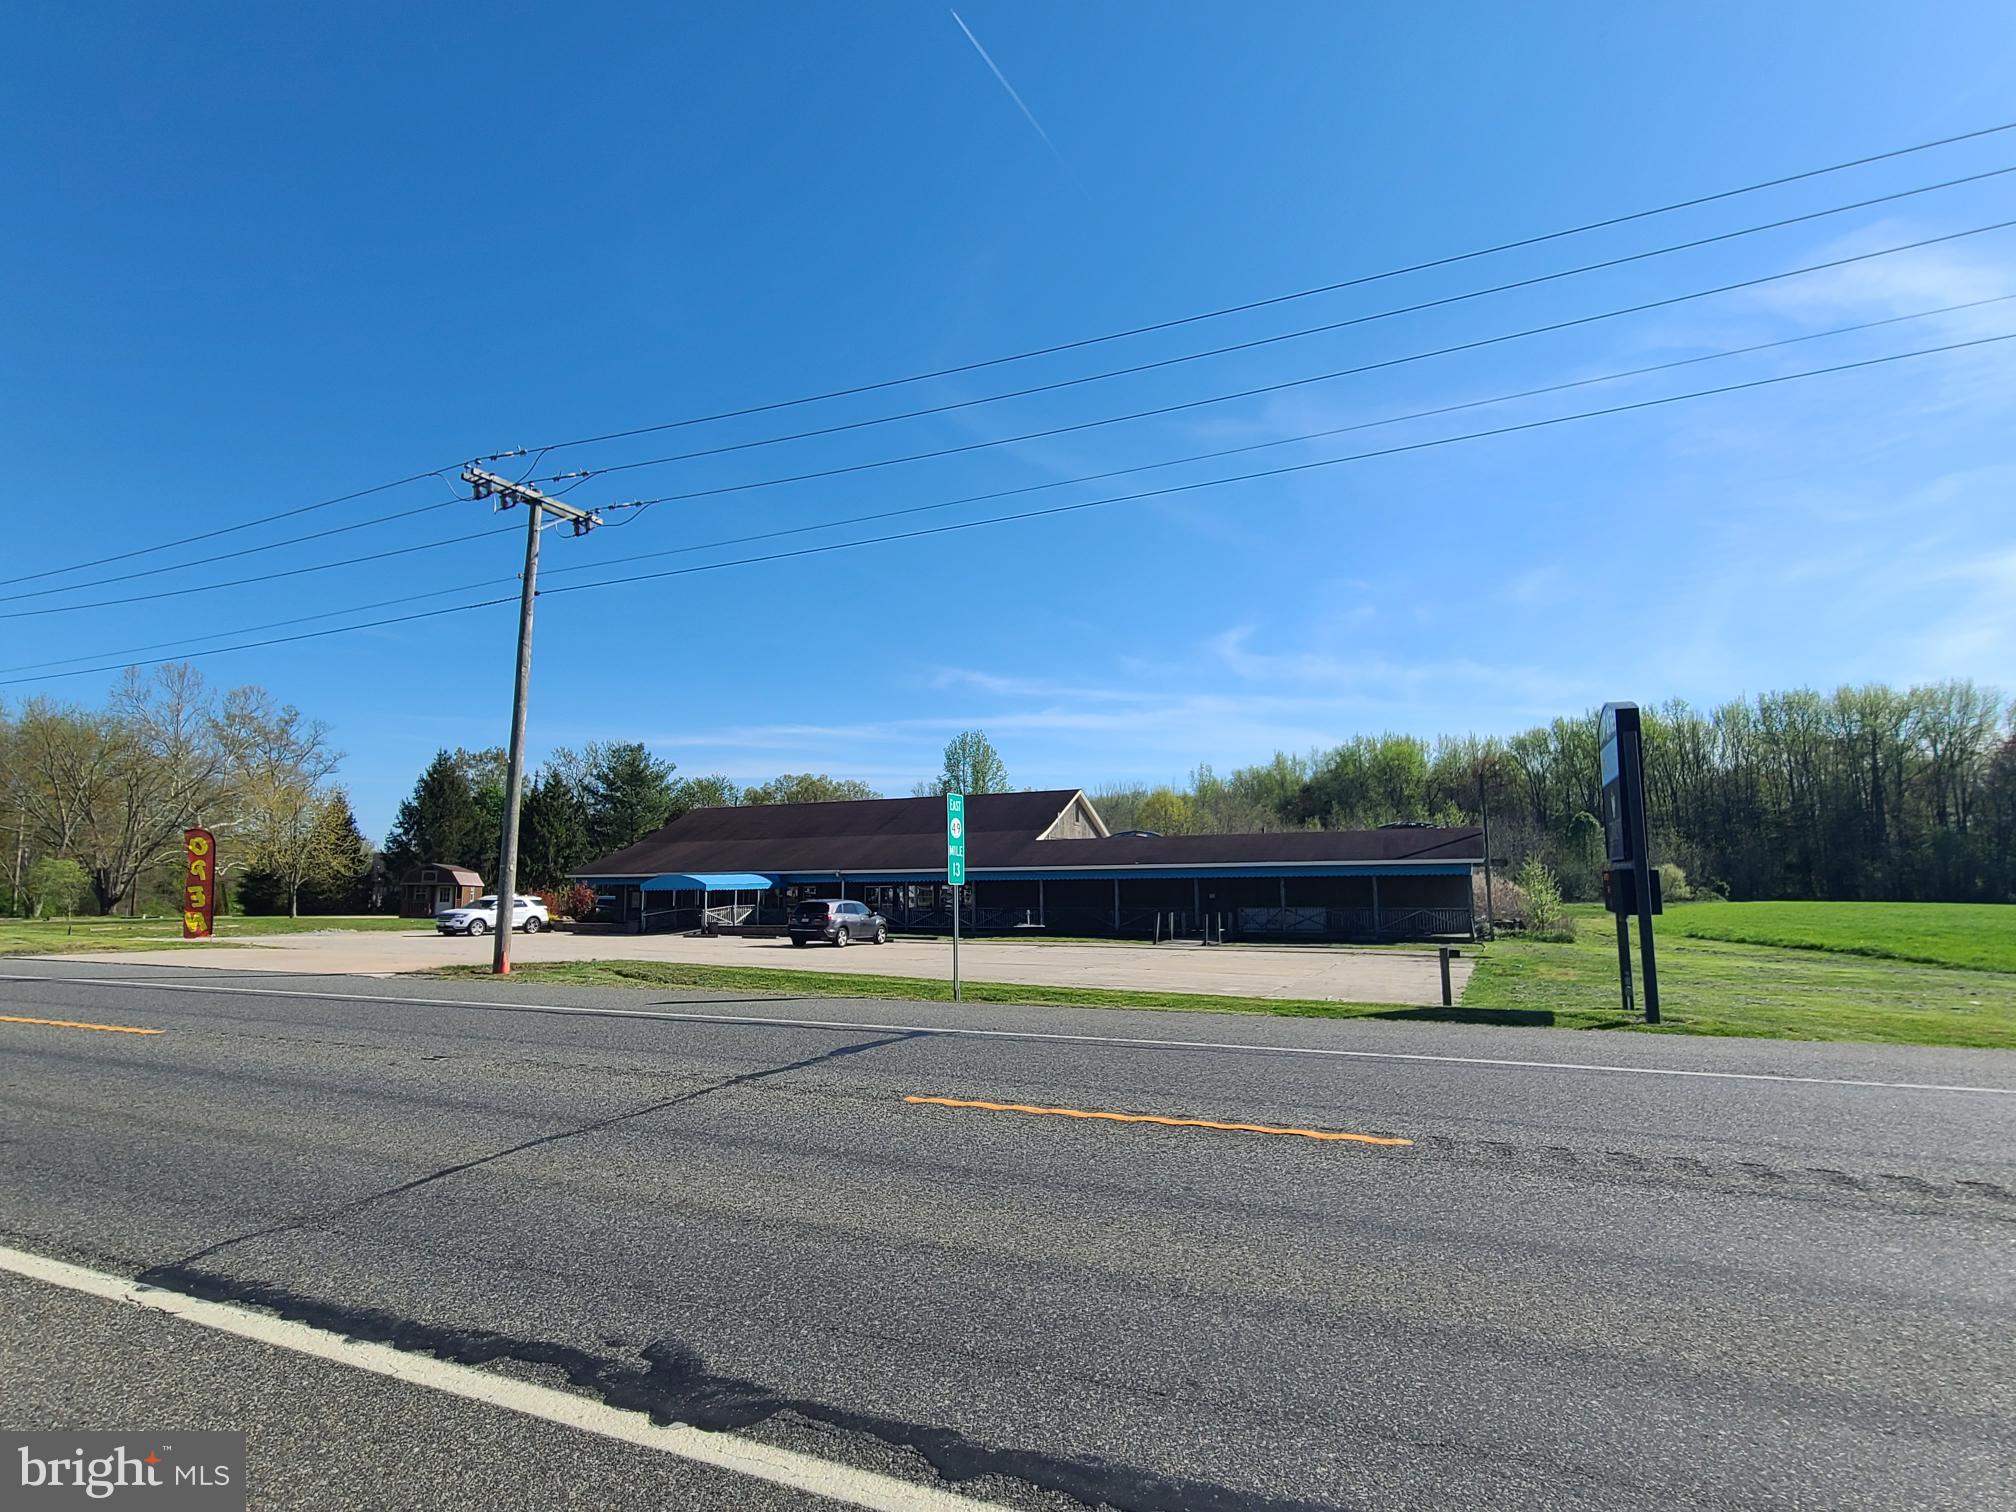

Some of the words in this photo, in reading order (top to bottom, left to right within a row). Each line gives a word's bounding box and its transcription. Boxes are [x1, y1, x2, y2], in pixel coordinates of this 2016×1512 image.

[950, 799, 961, 811] EAST
[951, 823, 961, 835] 49
[950, 845, 963, 857] MILE
[953, 862, 960, 877] 13
